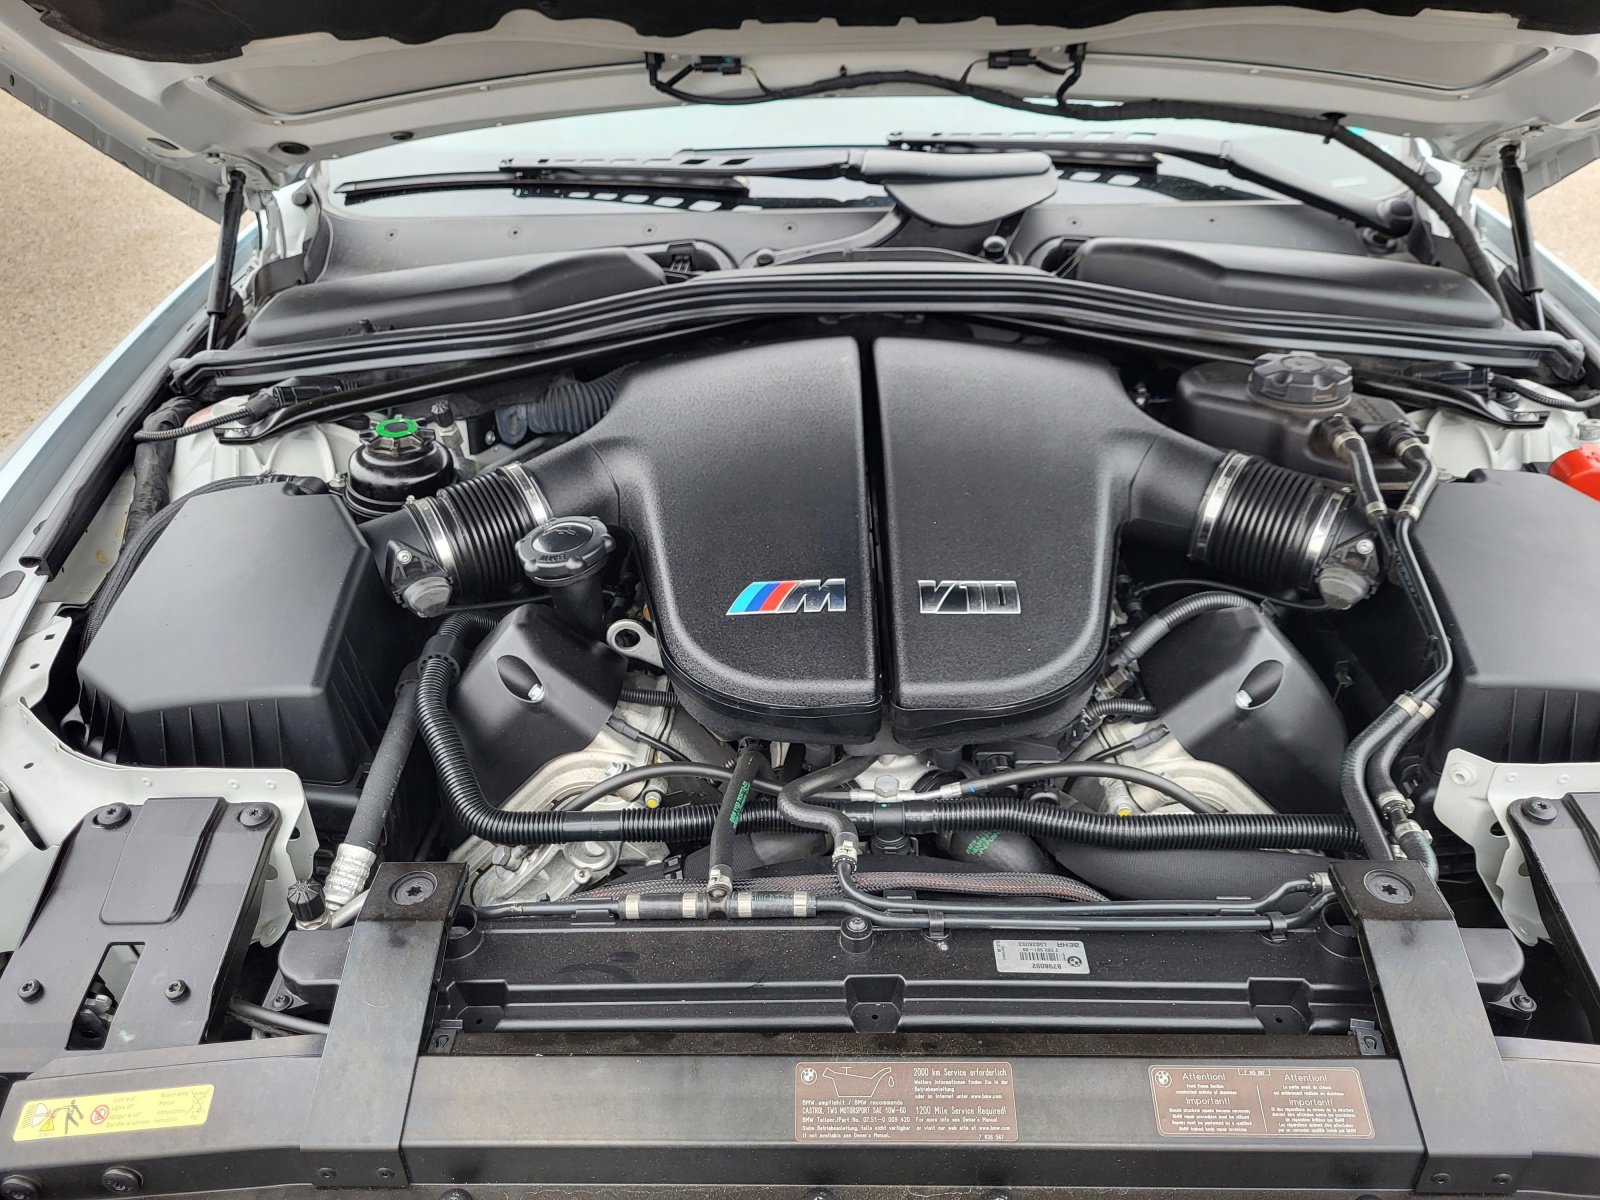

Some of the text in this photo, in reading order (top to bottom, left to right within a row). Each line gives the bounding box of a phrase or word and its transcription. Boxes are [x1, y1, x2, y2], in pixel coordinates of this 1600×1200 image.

[778, 578, 847, 613] M
[918, 580, 1021, 613] V10
[914, 1068, 1007, 1077] 2000 km Service erforderlich
[1183, 1073, 1226, 1081] Attention!
[1284, 1074, 1328, 1082] Attention!
[1186, 1097, 1231, 1106] Important!
[1288, 1098, 1333, 1106] Important!
[916, 1106, 1007, 1115] 1200 Mile Service Required!
